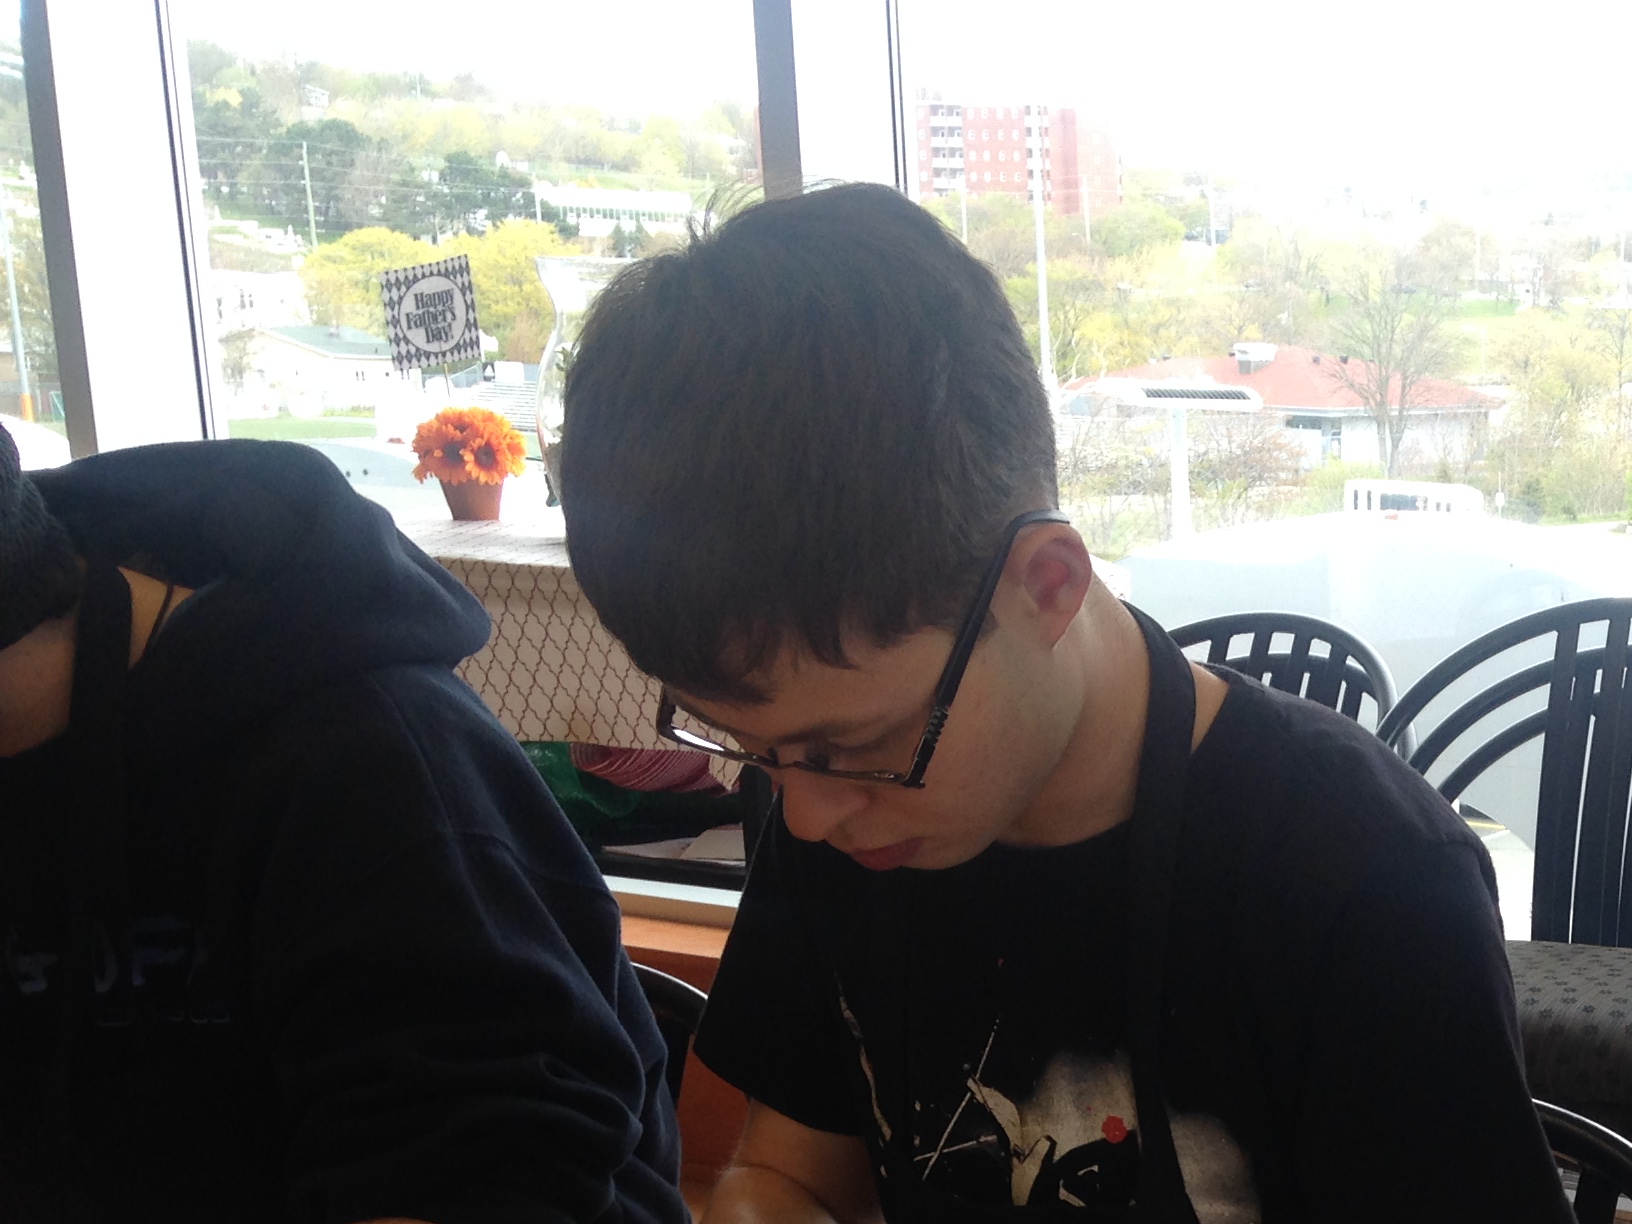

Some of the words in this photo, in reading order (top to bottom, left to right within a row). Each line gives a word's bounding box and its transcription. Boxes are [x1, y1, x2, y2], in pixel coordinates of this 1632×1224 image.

[414, 288, 454, 310] Happy
[406, 306, 457, 330] Father's
[425, 322, 454, 344] Day!
